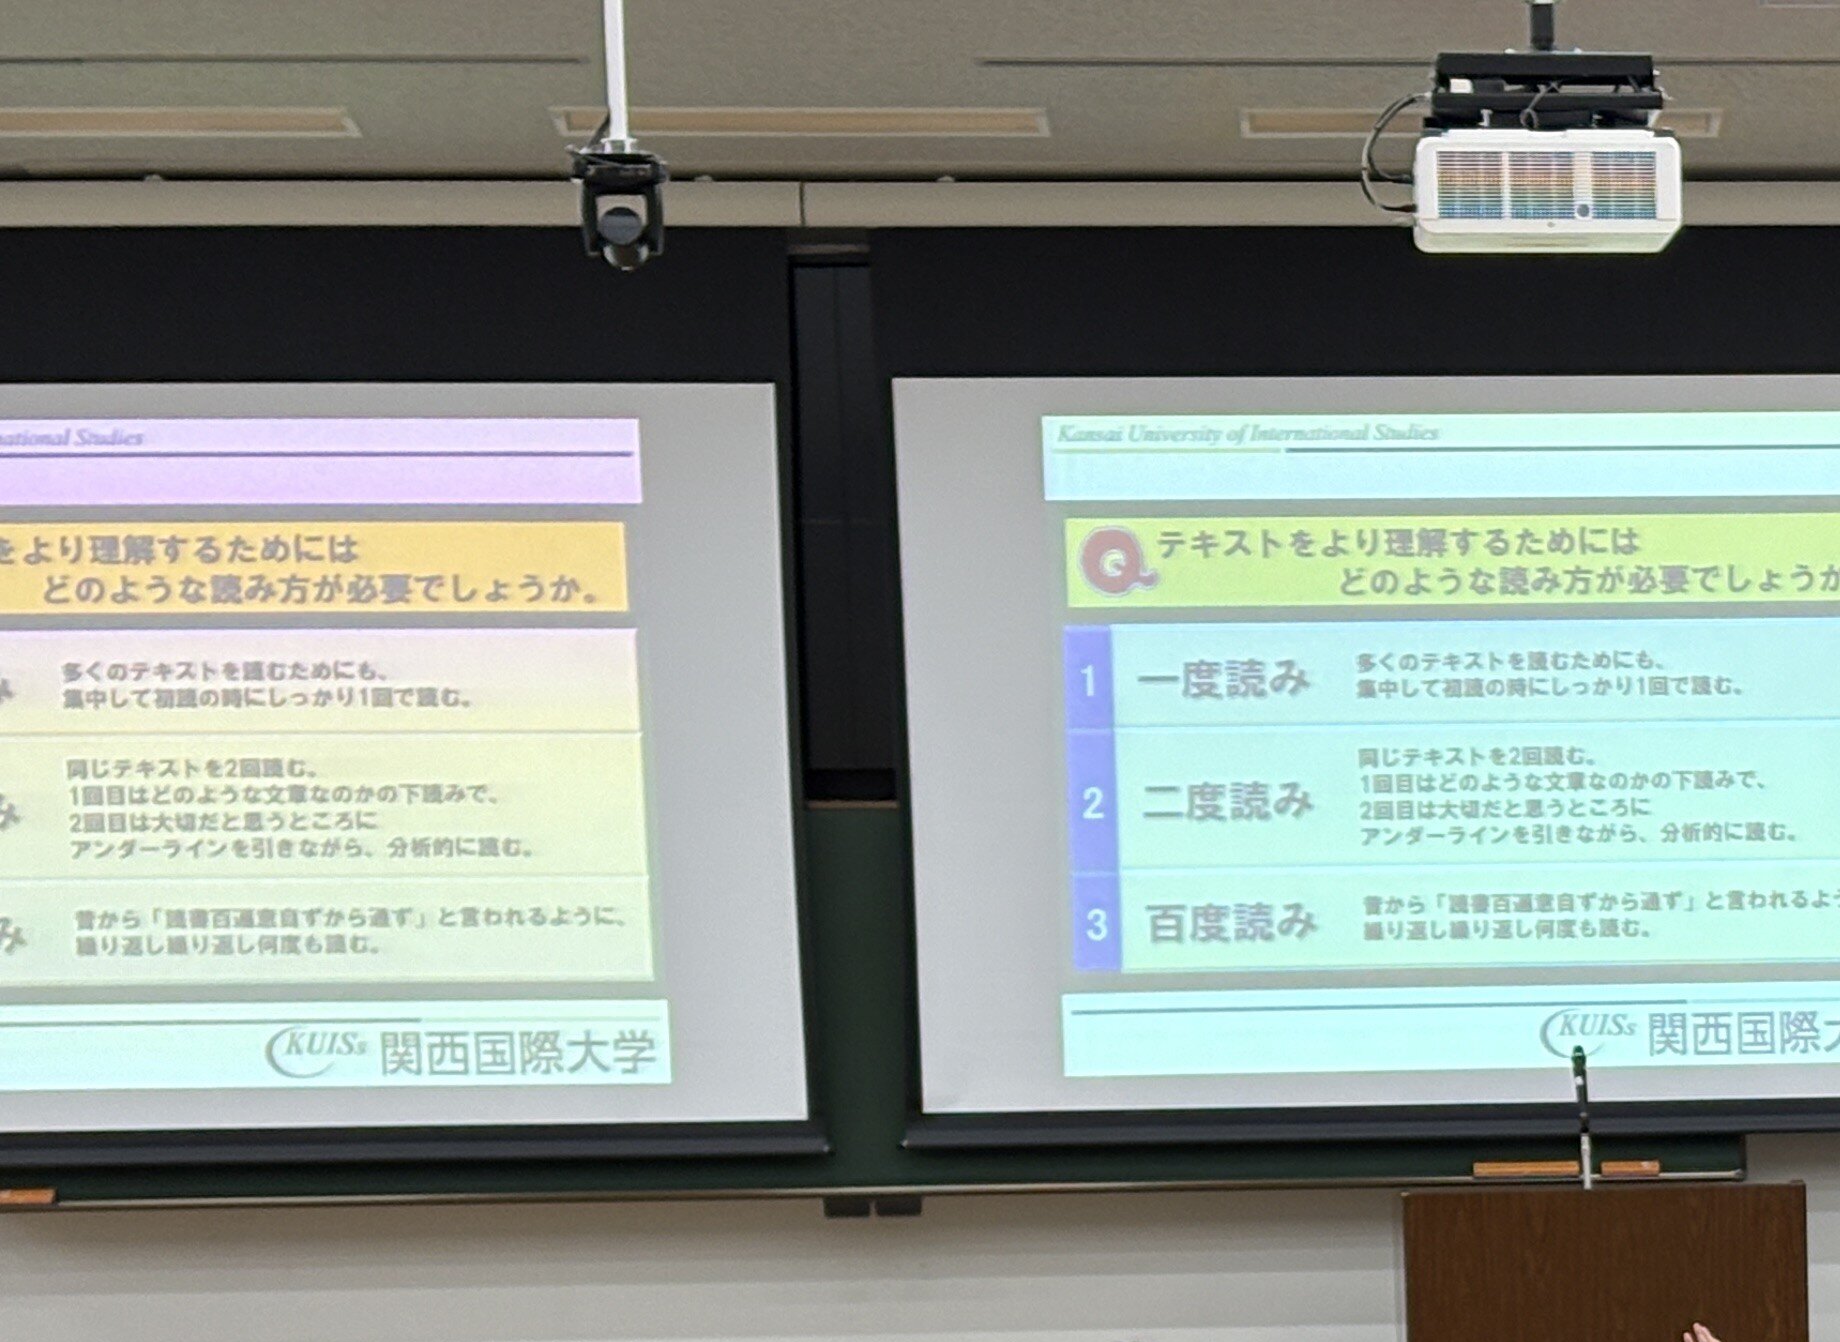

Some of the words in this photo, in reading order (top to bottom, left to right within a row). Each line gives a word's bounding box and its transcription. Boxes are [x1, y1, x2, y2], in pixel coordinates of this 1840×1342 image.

[73, 427, 144, 446] Studies
[1057, 424, 1122, 442] Kansai
[1128, 424, 1221, 446] University
[1225, 423, 1249, 446] of
[1250, 423, 1369, 442] International
[1373, 422, 1439, 441] Studies
[1157, 527, 1640, 558] テキストをより理解するためには
[43, 573, 598, 605] どのような読み方が必要でしょうか。
[61, 660, 388, 683] 多くのテキストを読むためにも、
[1356, 650, 1664, 675] 多くのテキストを読むためにも、
[1080, 665, 1095, 698] 1
[1137, 659, 1312, 700] 一度読み
[65, 758, 317, 780] 同じテキストを2回読む。
[1357, 746, 1597, 769] 同じテキストを2回読む。
[1083, 786, 1105, 819] 2
[1142, 781, 1315, 822] 二度読み
[1359, 797, 1652, 822] 2回目は大切だと思うところに
[69, 810, 378, 834] 2回目は大切だと思うところに
[1360, 821, 1798, 847] アンダーラインを引きながら、分析的に読む。
[69, 836, 535, 861] アンダーラインを引きながら、分析的に読む。
[1086, 908, 1108, 942] 3
[1145, 902, 1319, 944] 百度読み
[380, 1028, 658, 1079] 関西国際大学
